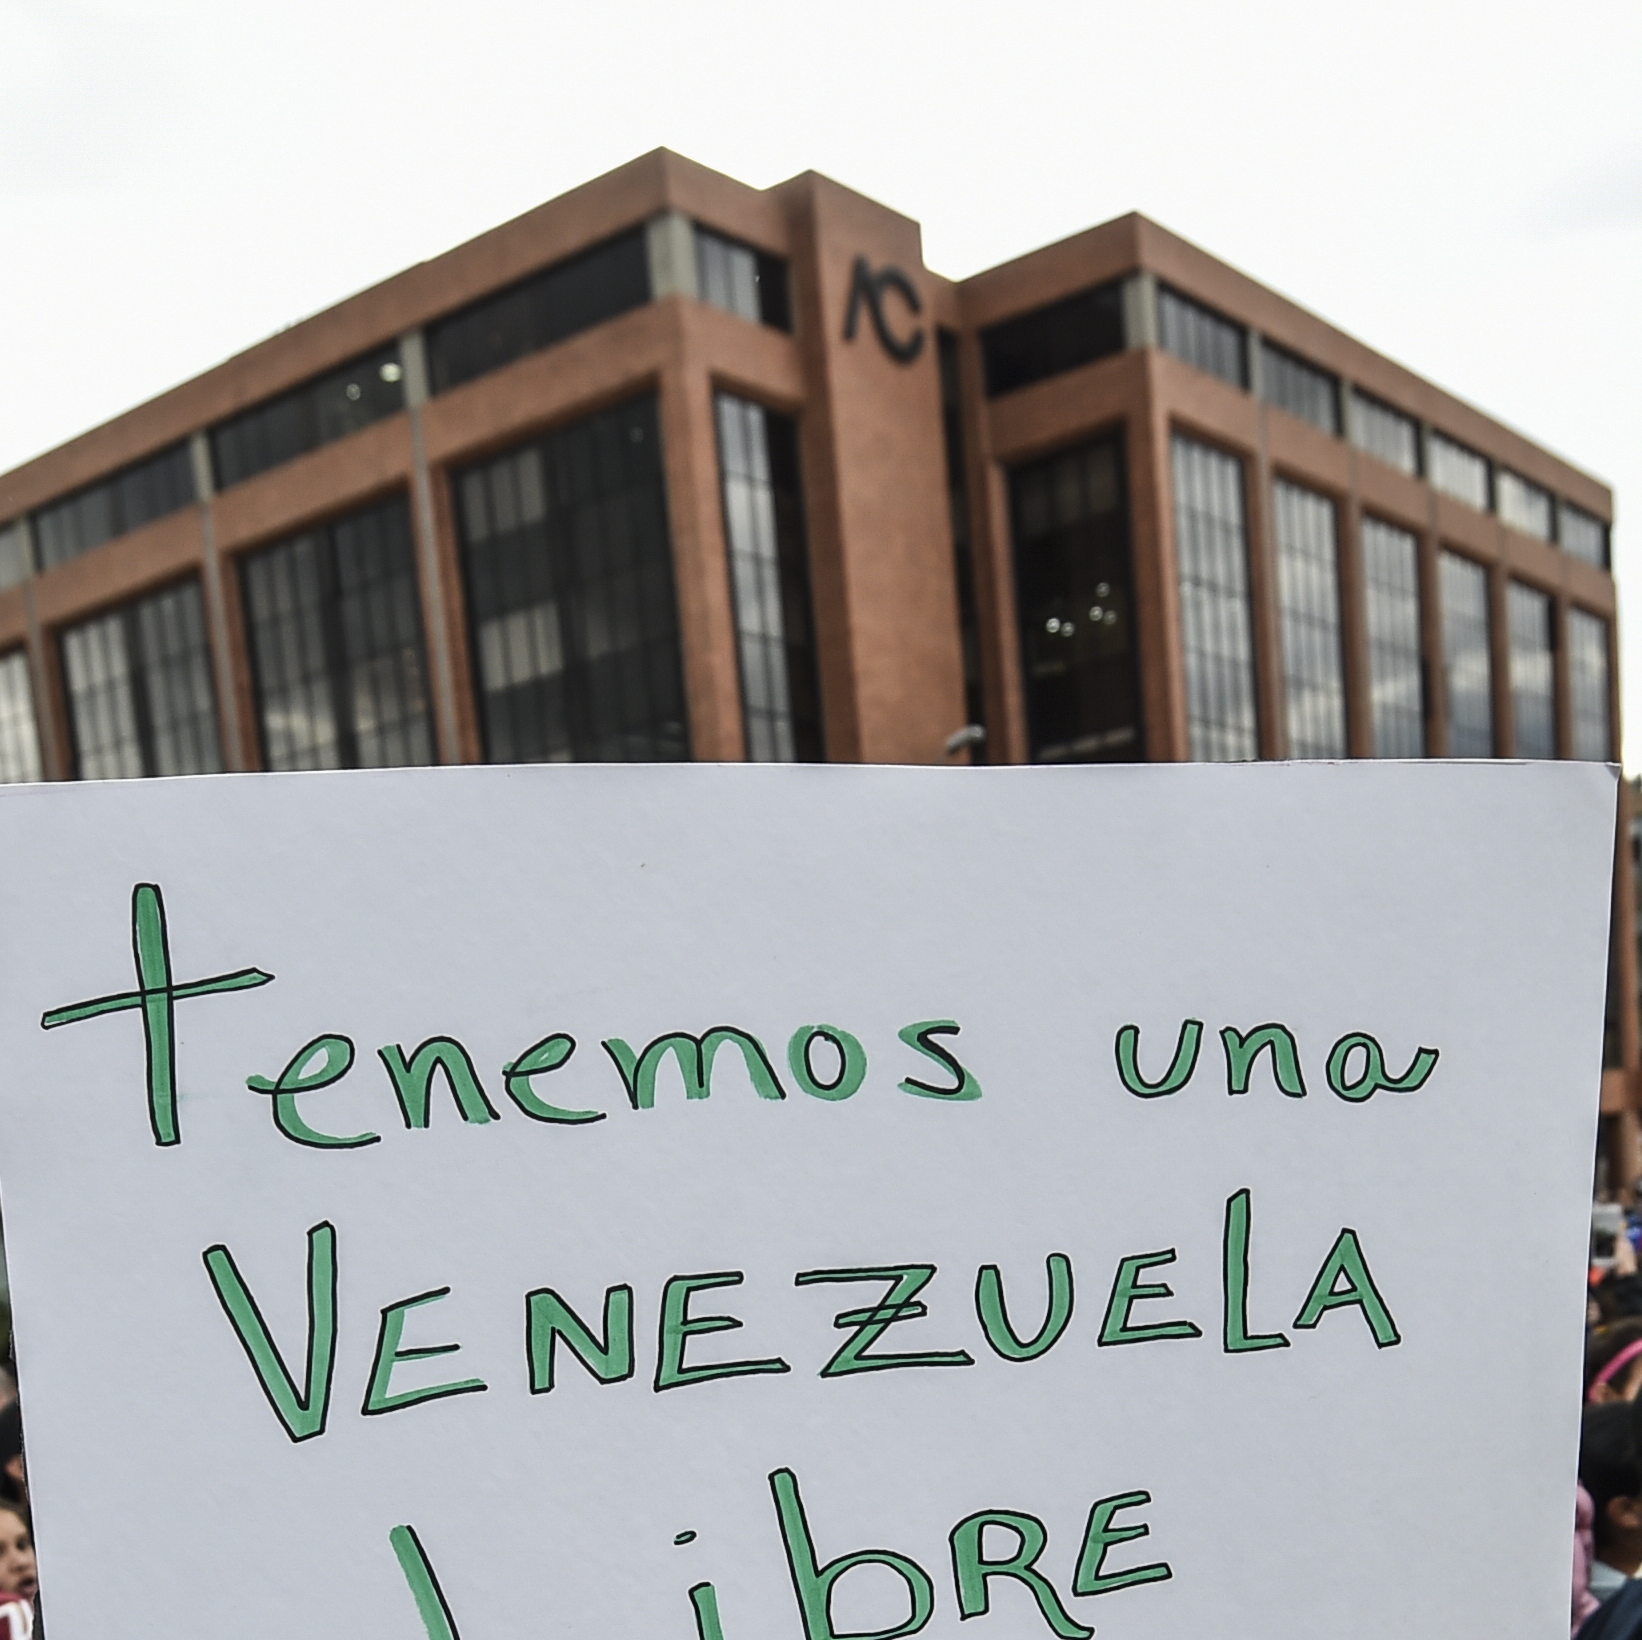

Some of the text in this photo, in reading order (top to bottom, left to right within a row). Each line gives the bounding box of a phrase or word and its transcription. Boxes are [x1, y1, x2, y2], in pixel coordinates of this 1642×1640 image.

[39, 882, 1441, 1150] tenemos una
[200, 1187, 1403, 1445] VENEZUELA
